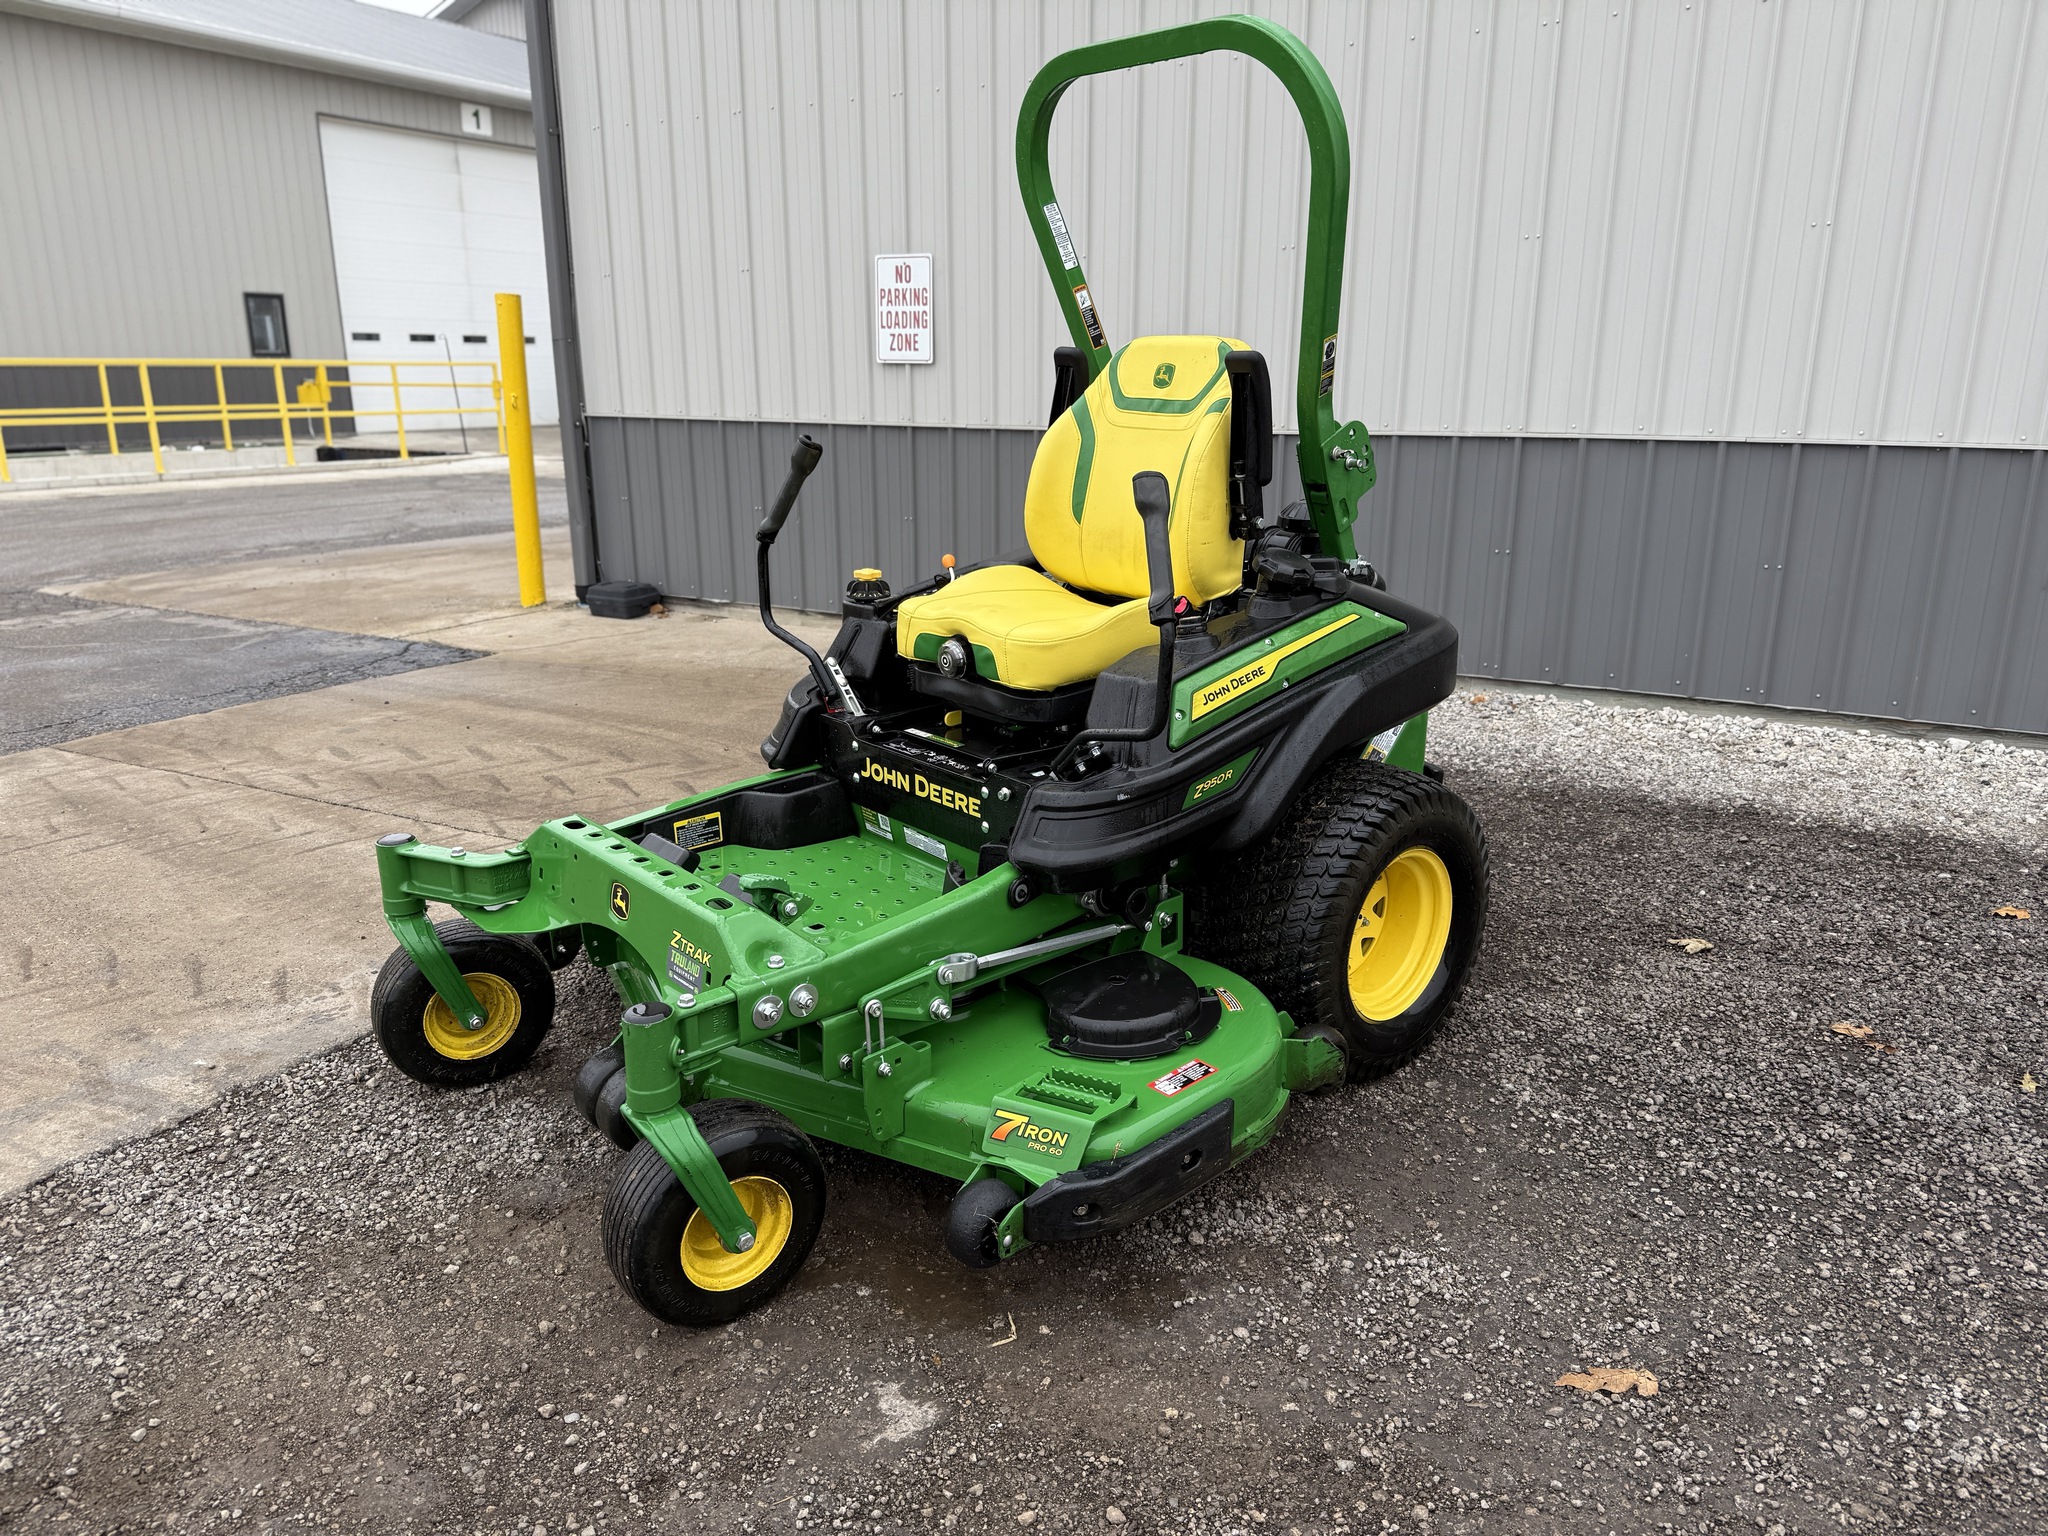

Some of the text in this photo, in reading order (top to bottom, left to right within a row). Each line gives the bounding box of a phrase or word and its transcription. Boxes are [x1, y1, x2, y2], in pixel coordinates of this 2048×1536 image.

[472, 108, 481, 130] 1
[895, 264, 912, 284] NO
[880, 287, 928, 307] PARKING
[880, 310, 928, 329] LOADING
[889, 333, 920, 352] ZONE
[1202, 665, 1266, 706] JOHN DEERE
[860, 757, 910, 793] JOHN
[914, 773, 982, 819] DEERE
[1193, 769, 1234, 800] Z950R
[670, 949, 701, 978] TRULAND
[1027, 1141, 1063, 1156] PRO 60
